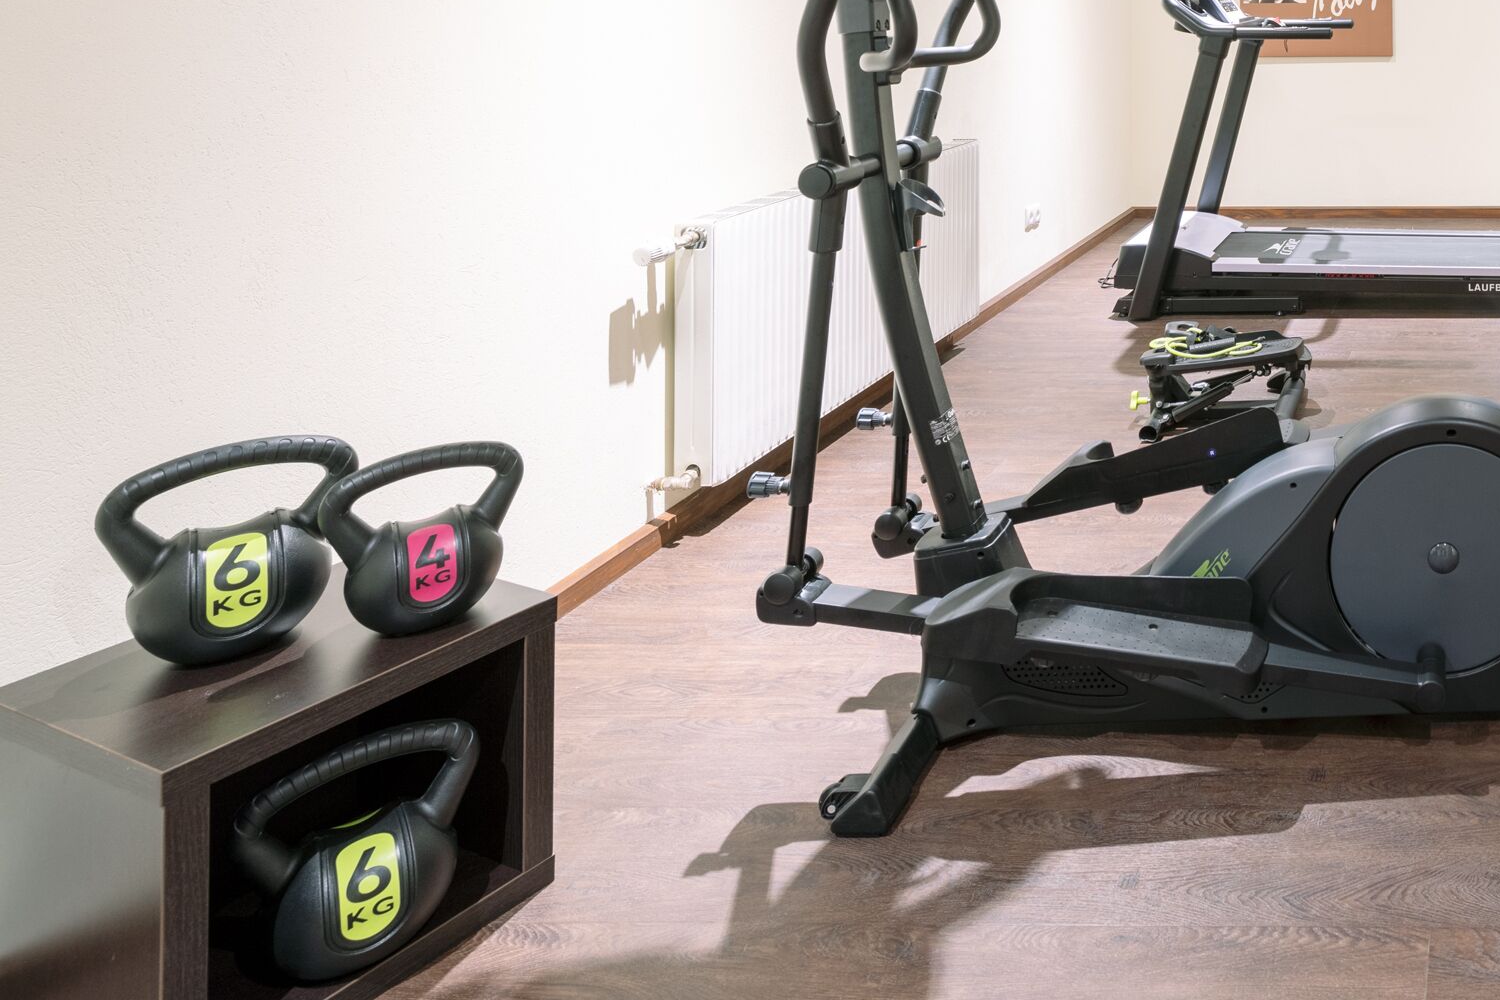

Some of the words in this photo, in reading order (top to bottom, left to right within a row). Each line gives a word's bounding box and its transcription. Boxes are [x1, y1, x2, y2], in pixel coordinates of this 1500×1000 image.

[213, 543, 261, 592] 6
[415, 533, 451, 569] 4
[415, 569, 451, 590] KG
[213, 590, 262, 617] KG
[346, 846, 392, 904] 6
[347, 896, 394, 931] KG
